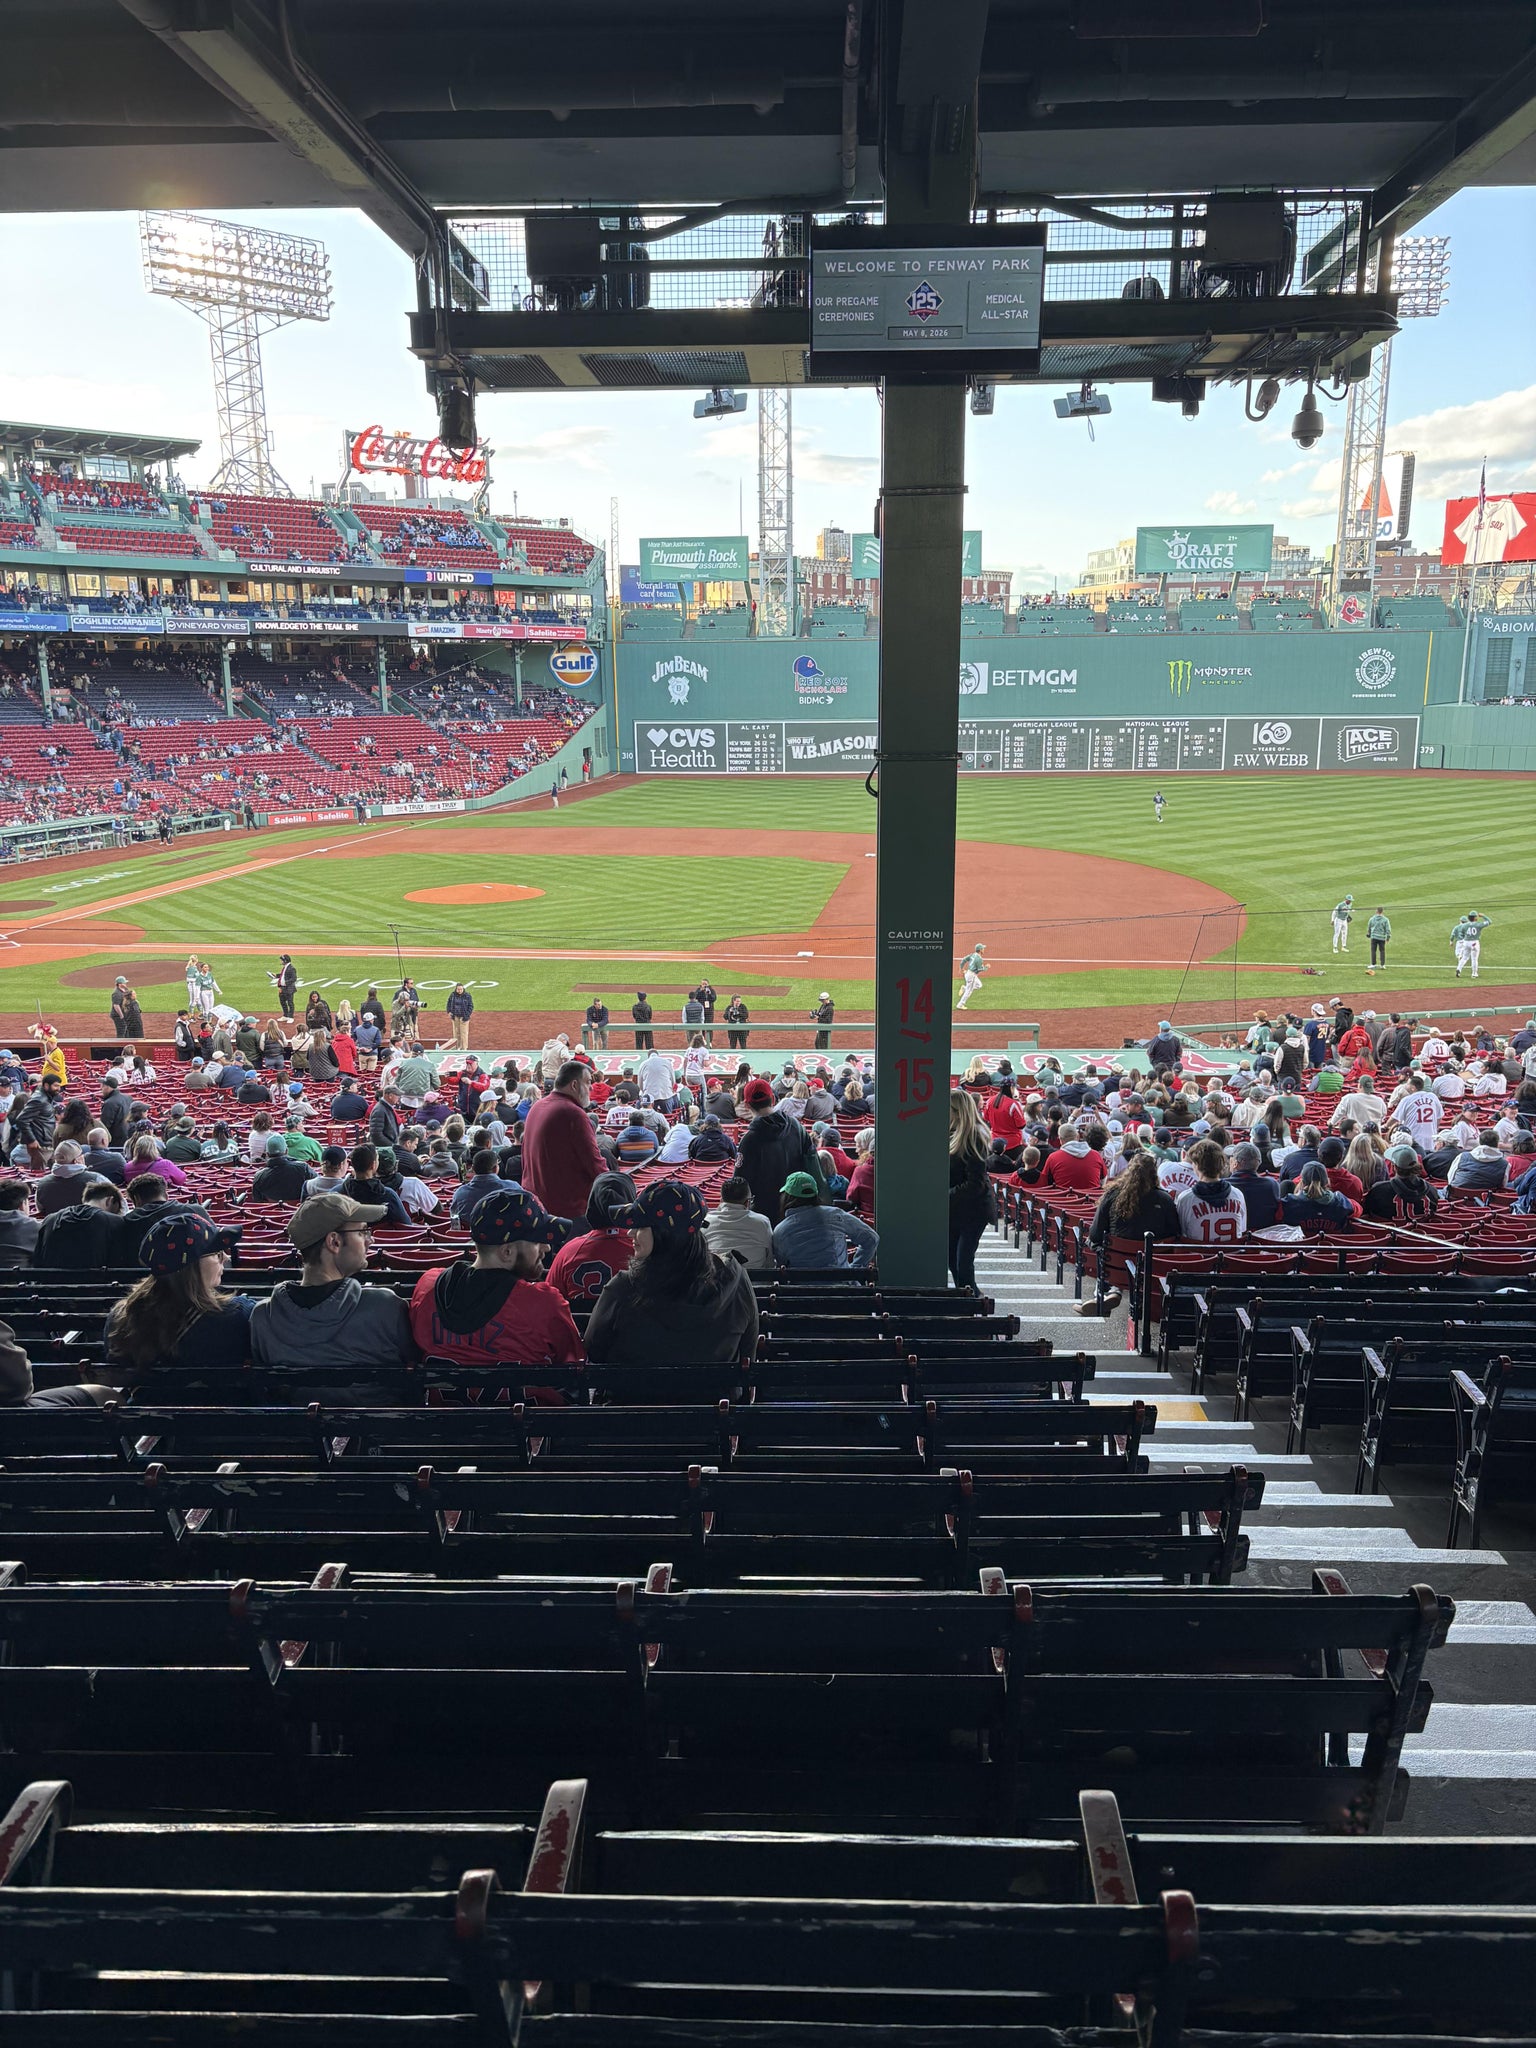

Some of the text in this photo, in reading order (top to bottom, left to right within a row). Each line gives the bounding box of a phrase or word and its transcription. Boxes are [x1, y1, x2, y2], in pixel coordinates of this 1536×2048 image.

[825, 259, 1030, 273] WELCOME TO FENWAY PARK
[815, 296, 879, 306] OUR PREGAME
[912, 292, 937, 310] 125
[986, 294, 1025, 304] MEDICAL
[818, 312, 874, 322] CEREMONIES
[981, 310, 1029, 320] ALL-STAR
[903, 329, 919, 337] MAY
[930, 329, 949, 337] 2026
[651, 548, 738, 564] Plymouth Rock
[1167, 543, 1238, 559] DRAFT
[250, 563, 340, 575] CULTURAL AND LINGUISTIC
[1175, 557, 1235, 569] KINGS
[437, 573, 475, 583] UNITED
[73, 617, 162, 627] COGHLIN COMPANIES
[176, 621, 220, 629] VINEYARD
[309, 623, 324, 631] THE
[1492, 618, 1536, 633] ABIOM
[528, 628, 557, 637] Safelite
[1358, 647, 1395, 662] IBEW 103
[552, 655, 594, 671] Gulf
[992, 669, 1078, 686] BETMGM
[1194, 666, 1253, 677] MONSTER
[799, 677, 848, 686] RED SOX
[799, 686, 848, 694] SCHOLARS
[799, 697, 825, 705] BIDMC
[670, 728, 716, 748] CVS
[1252, 721, 1292, 745] 160
[1350, 728, 1393, 744] ACE
[1350, 742, 1393, 754] TICKET
[1420, 746, 1434, 754] 379
[621, 752, 634, 760] 310
[650, 749, 717, 768] Health
[1233, 754, 1309, 767] F.W. WEBB
[274, 816, 307, 825] Safelite
[317, 811, 349, 821] Safelite
[888, 931, 944, 939] CAUTION!
[1466, 927, 1477, 935] 40
[895, 977, 935, 1024] 14
[1435, 1046, 1444, 1056] 11
[437, 1054, 746, 1076] BOTON
[895, 1058, 935, 1103] 15
[1053, 1073, 1062, 1085] 19
[1414, 1098, 1433, 1107] VELEZ
[1416, 1108, 1434, 1123] 12
[1162, 1172, 1198, 1188] WAKEFIE
[1200, 1218, 1237, 1242] 19
